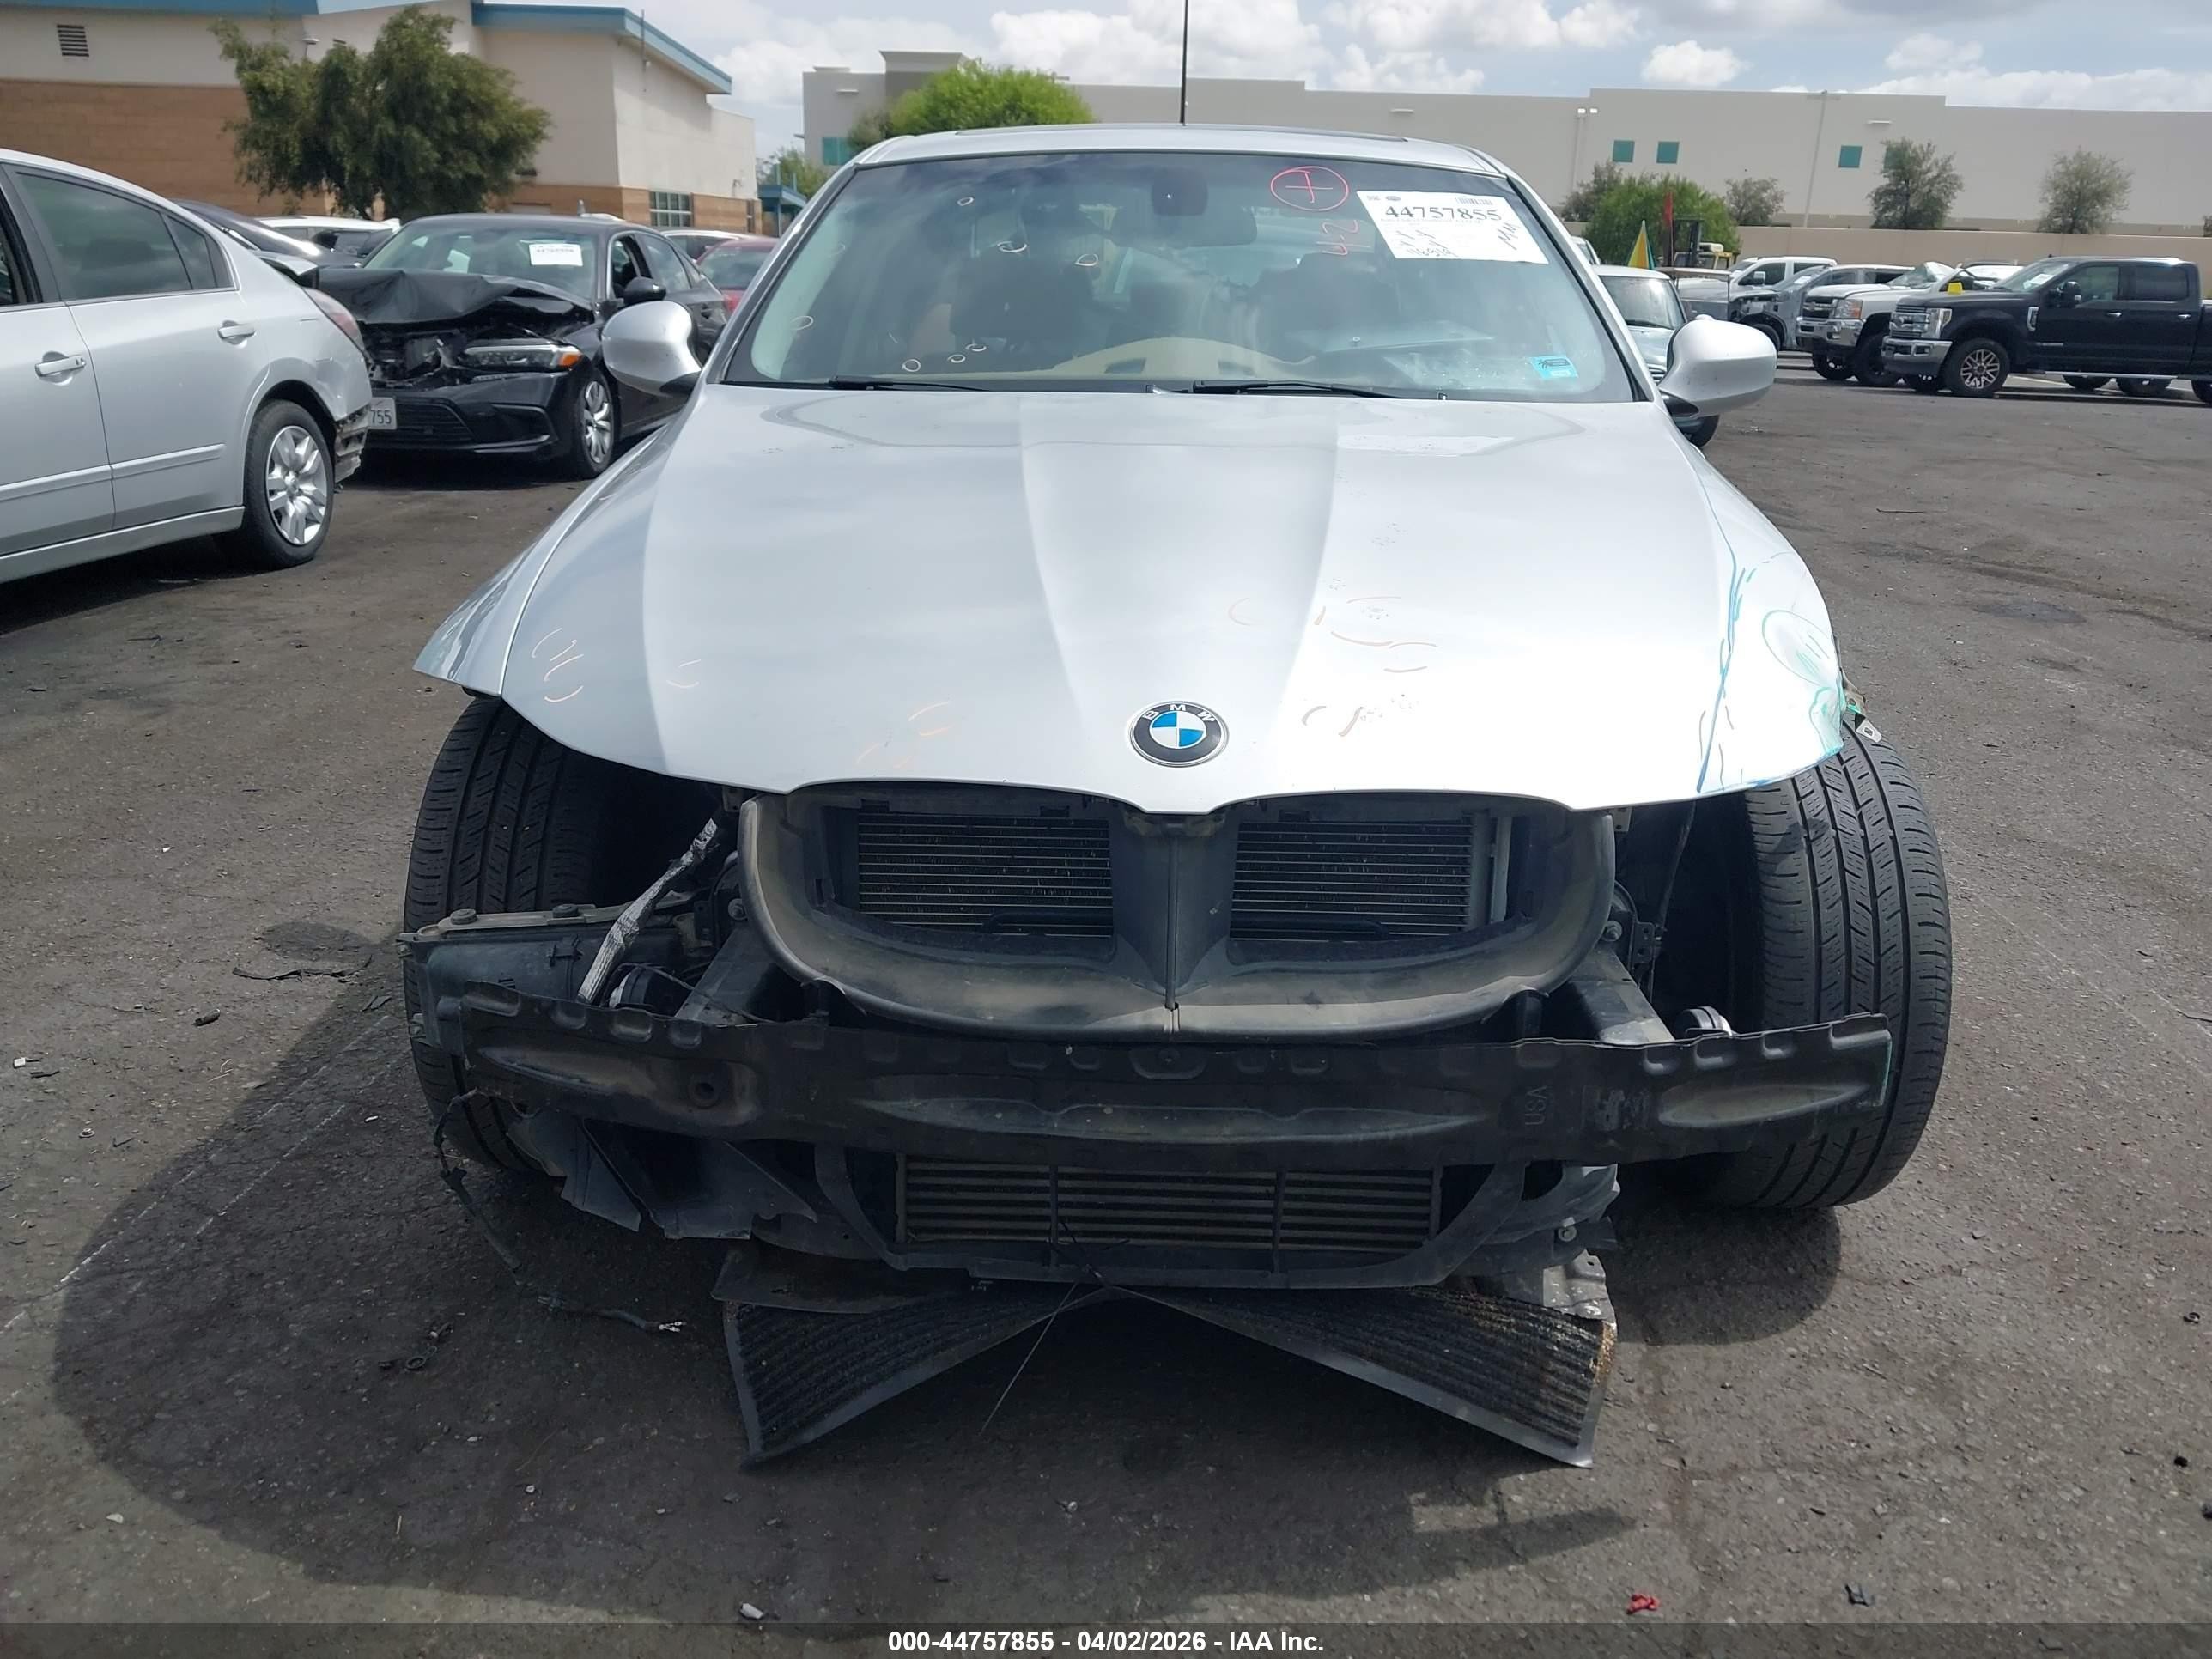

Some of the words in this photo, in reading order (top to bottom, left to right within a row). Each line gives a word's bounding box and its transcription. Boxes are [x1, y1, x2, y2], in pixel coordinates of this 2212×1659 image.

[1385, 205, 1503, 221] 44757855
[370, 410, 392, 424] 755
[1142, 703, 1216, 723] BMW
[1524, 1085, 1548, 1126] USA
